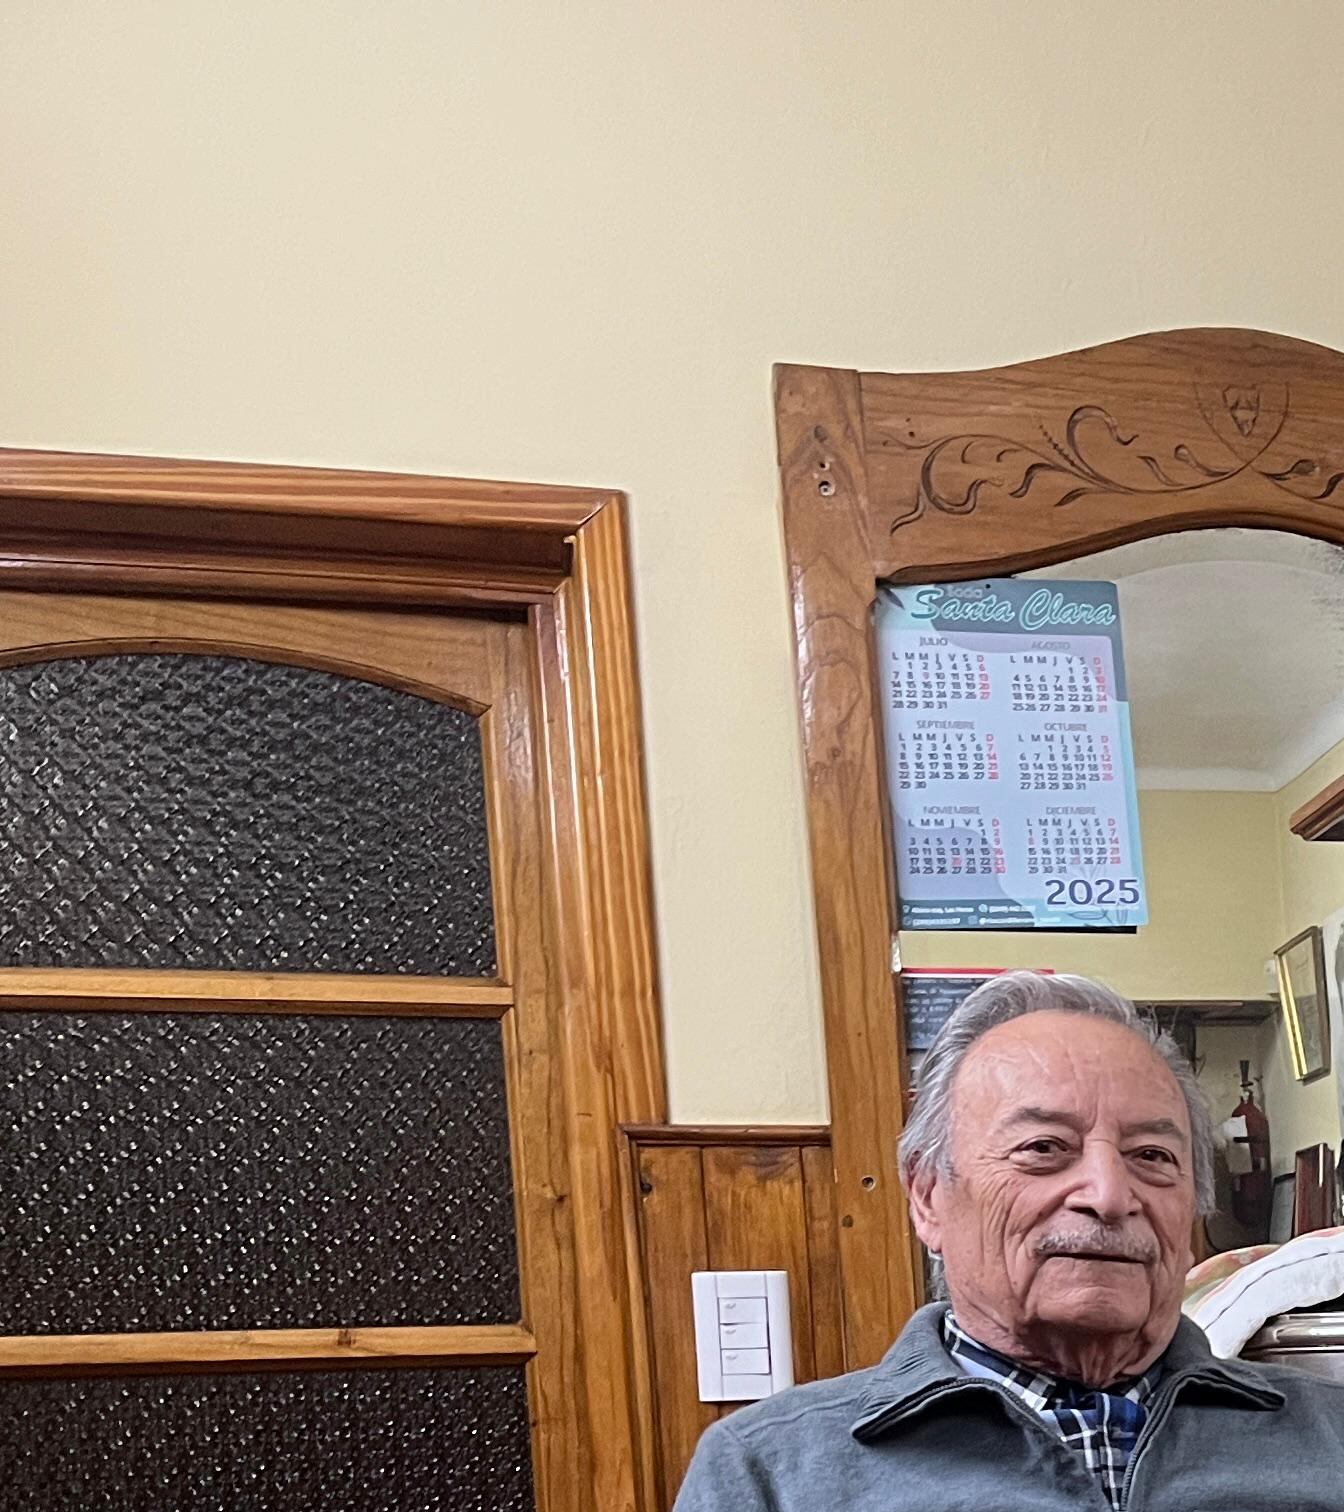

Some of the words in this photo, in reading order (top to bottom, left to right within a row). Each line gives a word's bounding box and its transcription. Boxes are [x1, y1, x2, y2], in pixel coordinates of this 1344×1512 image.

[911, 588, 1015, 622] Santa
[1019, 588, 1116, 631] Clara
[920, 637, 947, 646] JULIO
[1032, 641, 1070, 649] AGOSTO
[892, 652, 898, 660] L
[905, 652, 914, 661] M
[920, 653, 928, 661] M
[935, 653, 939, 664] J
[949, 654, 955, 662] V
[1024, 656, 1033, 664] M
[1037, 656, 1046, 664] M
[1053, 656, 1057, 666] J
[1066, 656, 1072, 664] V
[923, 662, 928, 670] 2
[966, 663, 971, 671] 5
[1014, 674, 1019, 682] 4
[917, 720, 974, 729] SEPTIEMBRE
[1045, 723, 1087, 731] OCTUBRE
[899, 733, 904, 741] L
[913, 733, 922, 741] M
[927, 733, 936, 741] M
[943, 733, 947, 743] J
[970, 734, 975, 742] S
[986, 734, 993, 742] D
[1018, 734, 1024, 742] L
[1032, 734, 1040, 742] M
[1060, 734, 1064, 744] J
[1073, 735, 1080, 743] V
[1087, 735, 1092, 743] S
[902, 743, 906, 751] 1
[916, 743, 922, 751] 2
[931, 743, 937, 751] 3
[1088, 745, 1093, 753] 4
[900, 752, 906, 760] 8
[1020, 753, 1026, 761] 6
[1034, 753, 1040, 761] 7
[1050, 753, 1055, 761] 8
[1062, 753, 1068, 761] 9
[924, 806, 980, 814] NOVIEMBRE
[1046, 807, 1096, 815] DICIEMBRE
[908, 819, 914, 827] L
[921, 819, 930, 827] M
[935, 818, 944, 827] M
[951, 819, 954, 829] J
[964, 818, 970, 827] V
[978, 818, 983, 827] S
[992, 818, 999, 827] D
[1027, 818, 1032, 826] L
[1039, 818, 1048, 826] M
[1052, 818, 1061, 826] M
[1067, 819, 1071, 829] J
[1081, 818, 1087, 826] V
[1095, 818, 1100, 826] S
[1108, 818, 1115, 826] D
[1045, 879, 1140, 905] 2025
